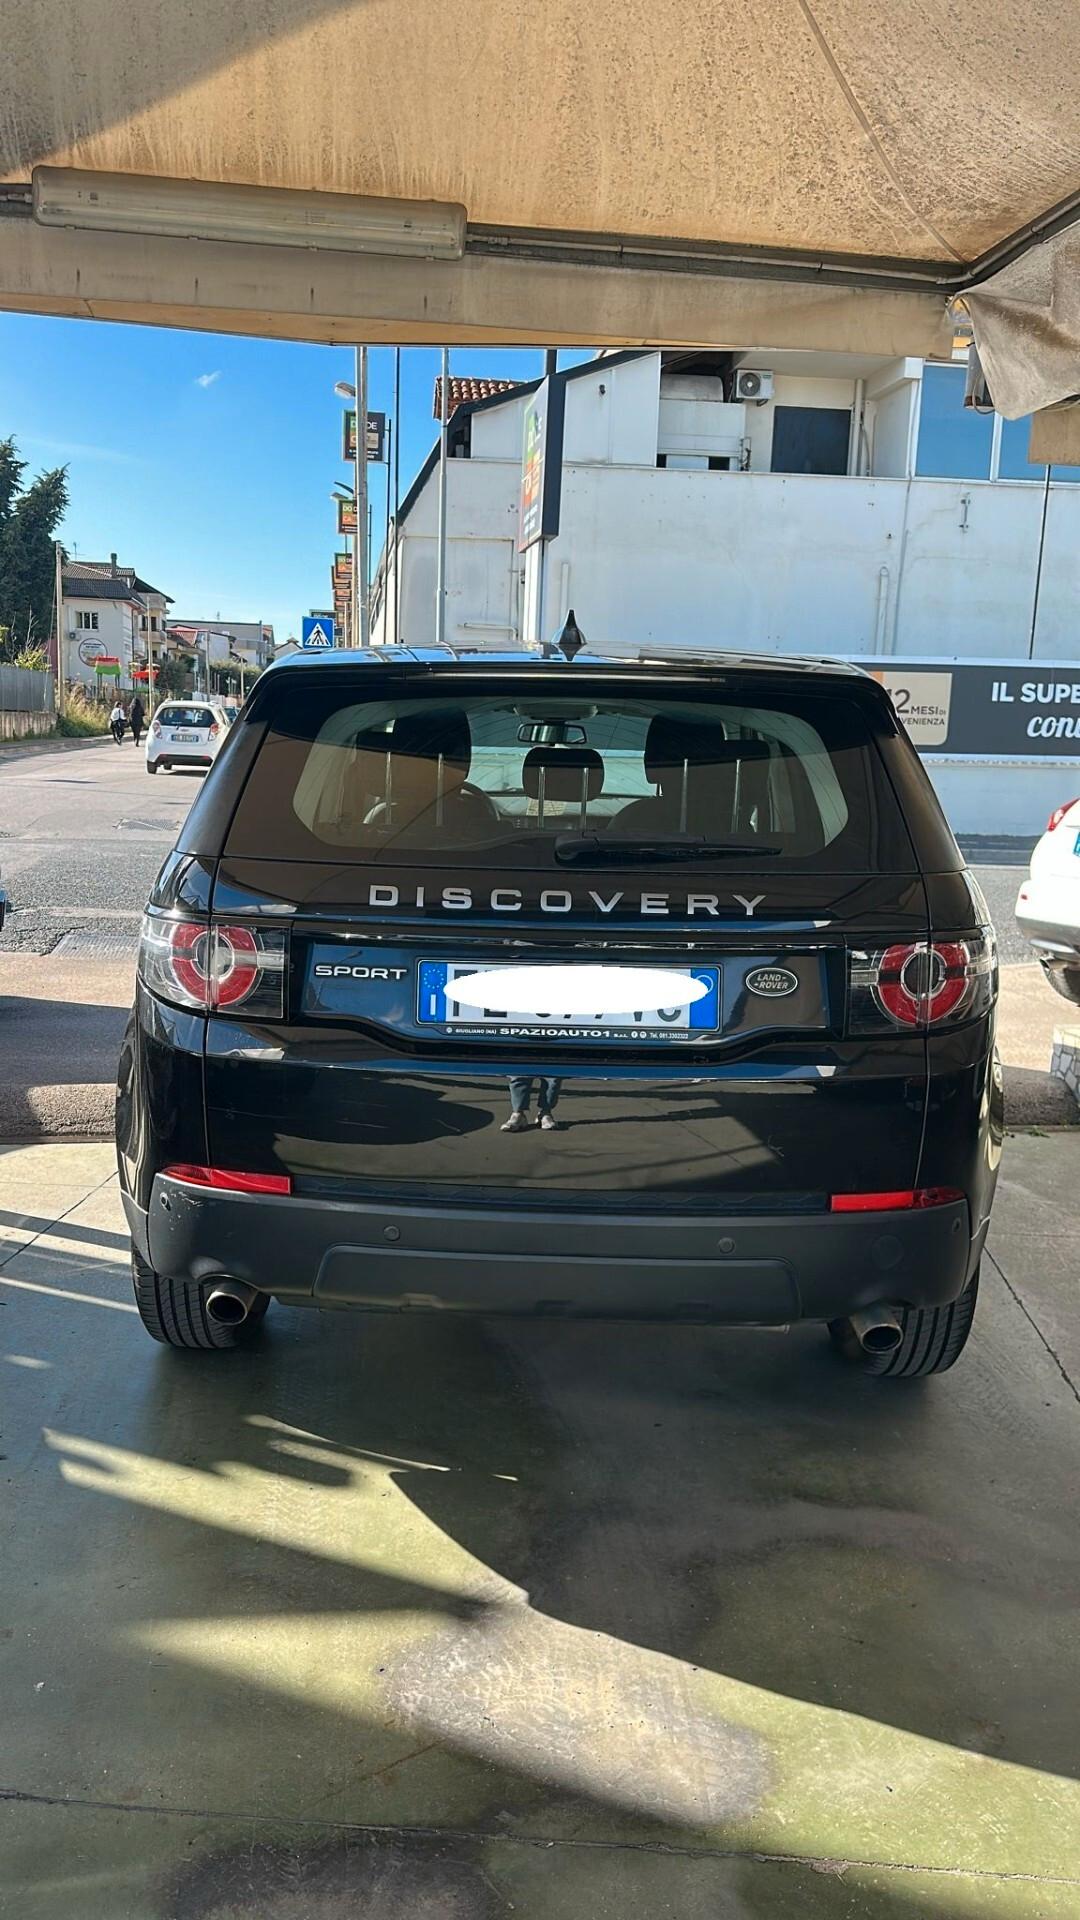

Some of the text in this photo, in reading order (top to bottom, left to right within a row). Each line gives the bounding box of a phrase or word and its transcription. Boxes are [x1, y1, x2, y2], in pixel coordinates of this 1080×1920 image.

[991, 681, 1015, 702] IL
[887, 688, 910, 714] 2
[911, 705, 939, 715] MESI
[901, 717, 945, 726] VENIENZA
[369, 885, 766, 916] DISCOVERY
[315, 965, 407, 980] SPORT
[500, 1028, 610, 1037] SPAZIOAUTO1
